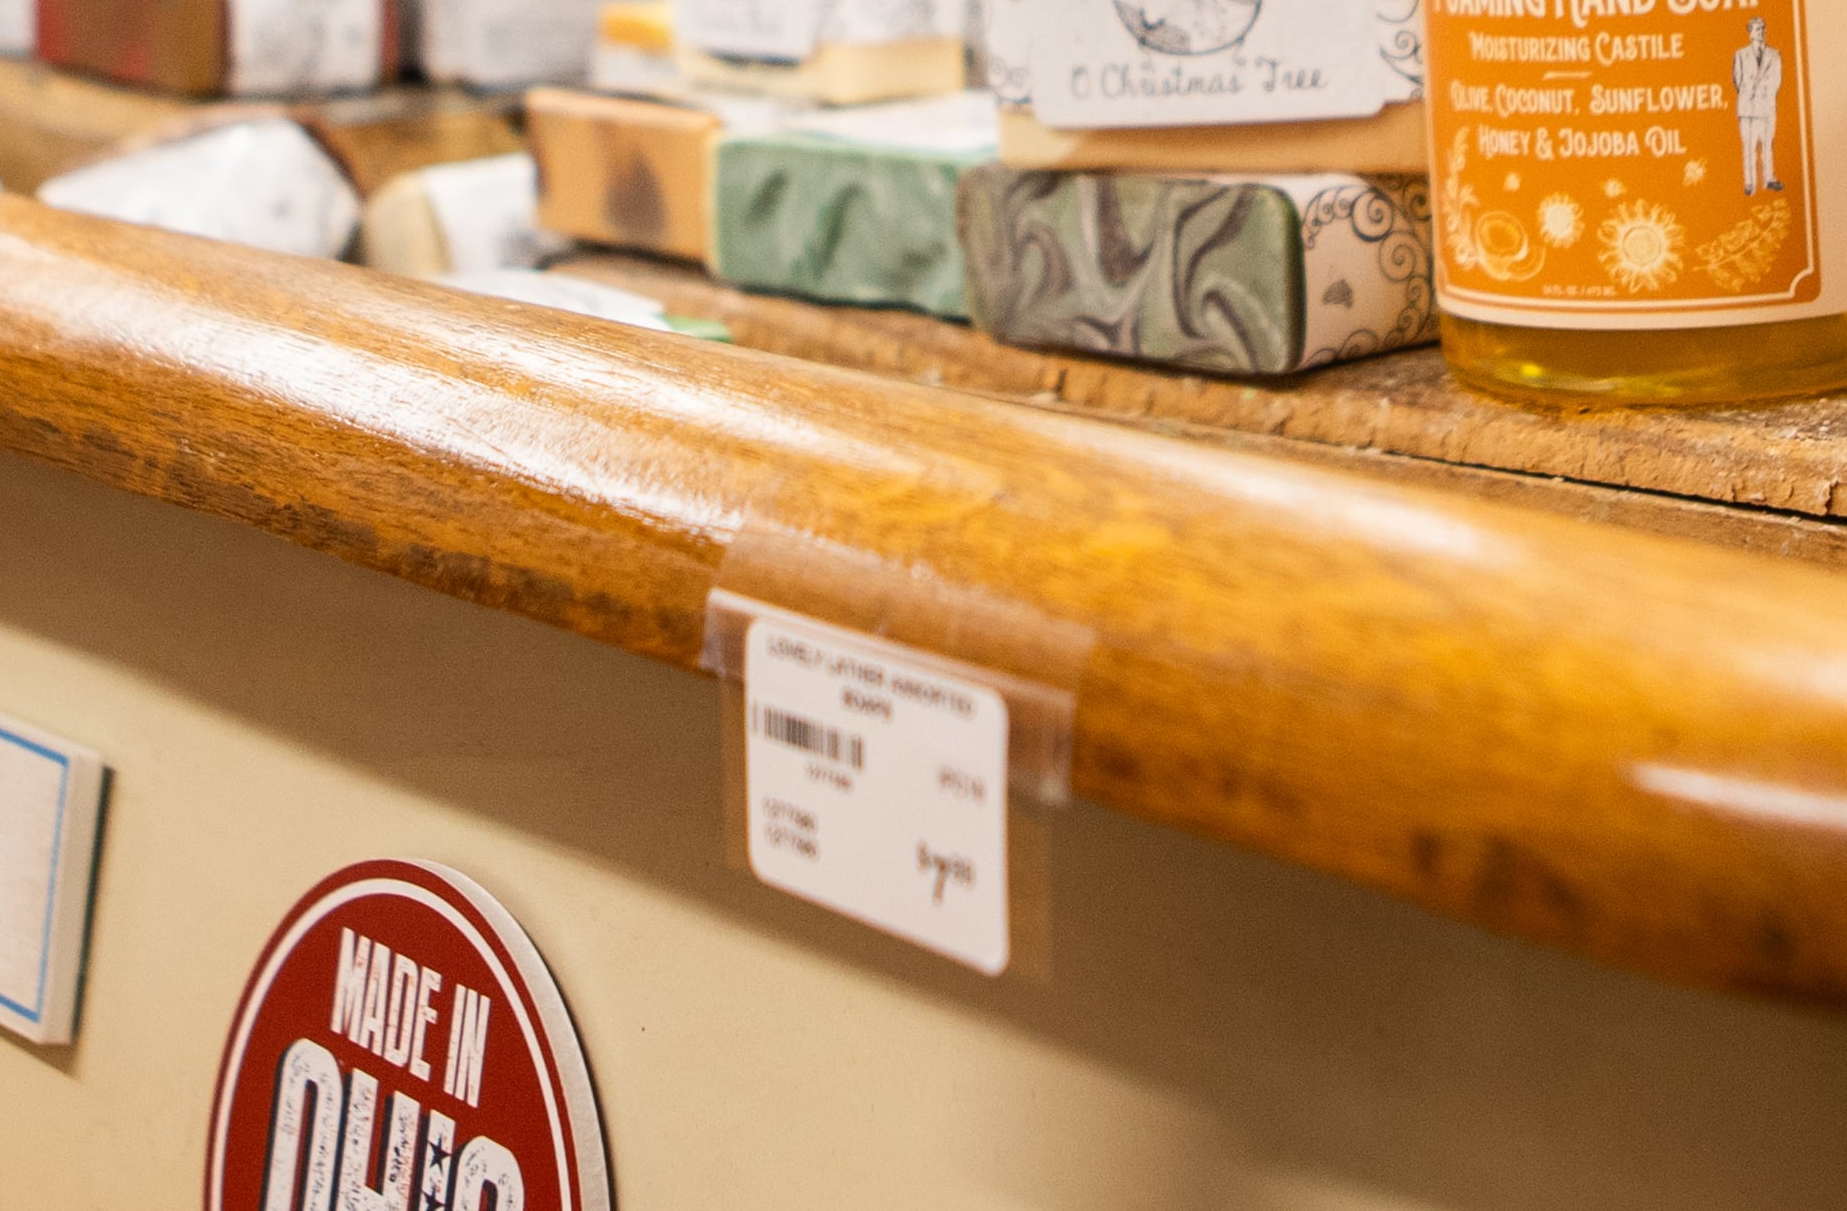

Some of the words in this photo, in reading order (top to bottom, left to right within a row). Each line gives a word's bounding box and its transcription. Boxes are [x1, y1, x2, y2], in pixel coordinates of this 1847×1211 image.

[1468, 31, 1591, 63] MOISTURIZING
[1595, 32, 1684, 66] CASTILE
[1254, 56, 1329, 93] Tree
[1477, 124, 1532, 160] HONEY
[1535, 127, 1555, 161] &
[1558, 127, 1640, 159] JOJOBA
[1645, 125, 1687, 158] OIL
[330, 926, 442, 1082] MADE
[443, 983, 492, 1109] IN
[262, 1037, 526, 1211] OH
